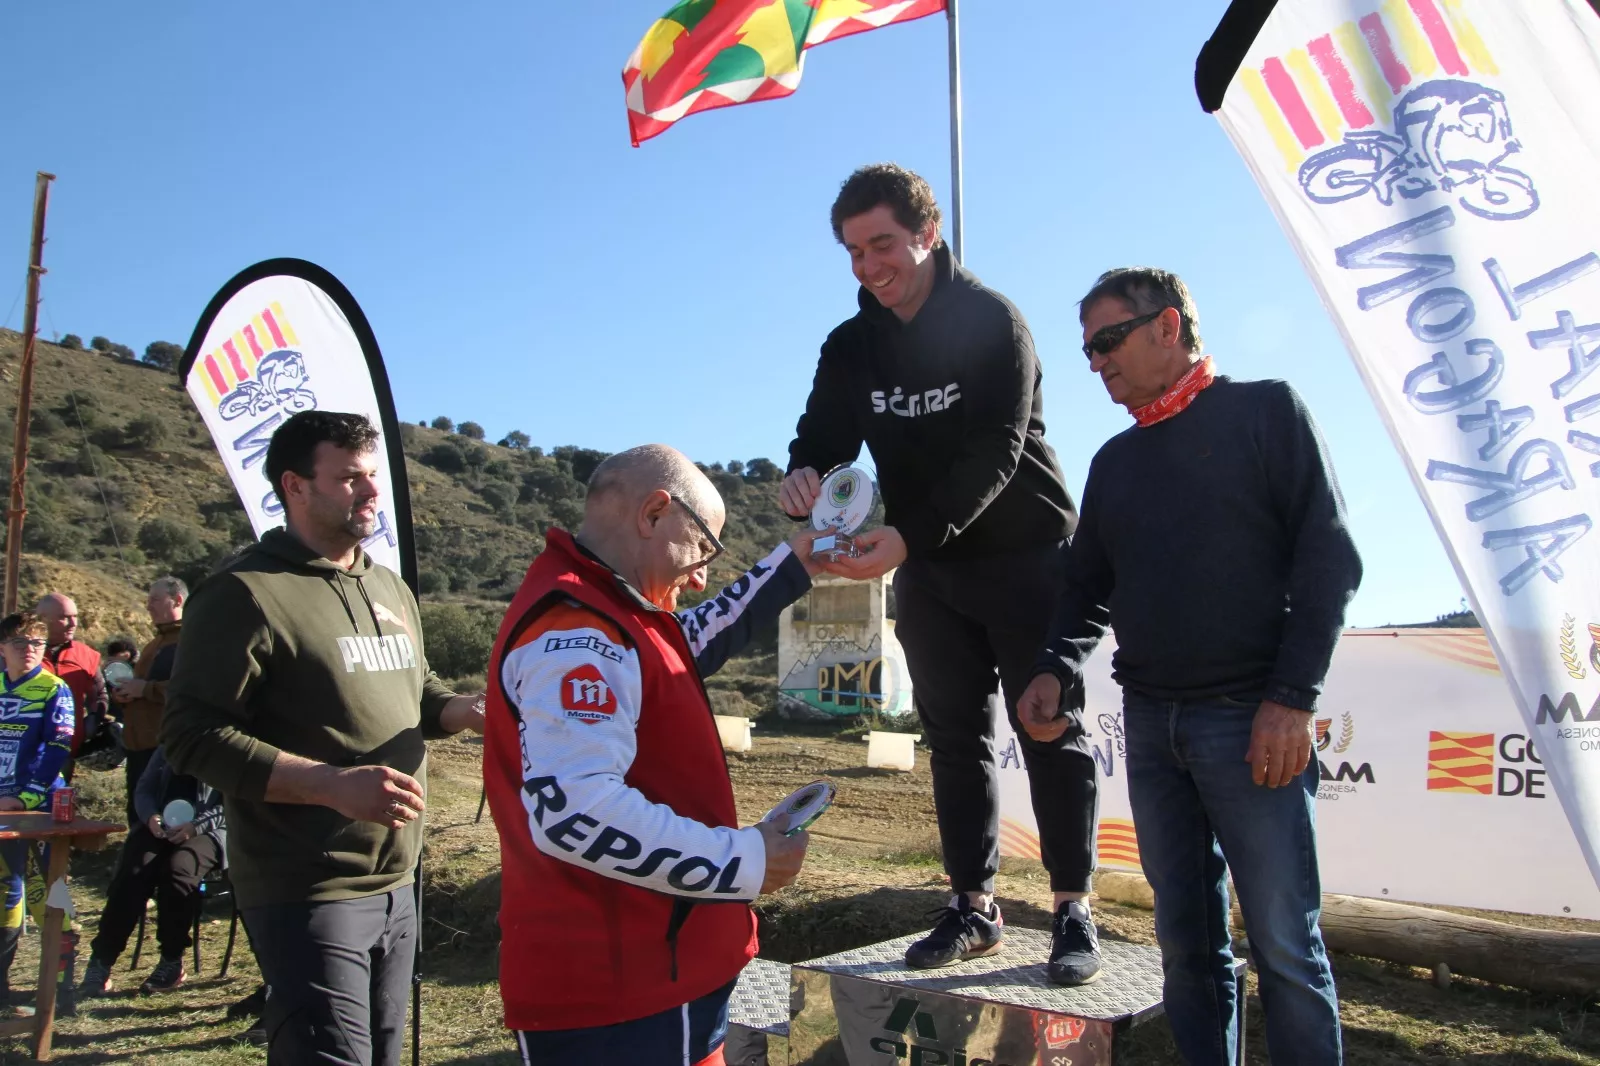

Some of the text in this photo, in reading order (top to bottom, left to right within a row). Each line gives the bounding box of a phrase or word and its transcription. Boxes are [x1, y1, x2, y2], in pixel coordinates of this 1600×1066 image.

[336, 633, 416, 672] PUMA
[567, 710, 611, 721] Montesa
[1497, 767, 1546, 799] DE
[525, 775, 742, 894] REPSOL
